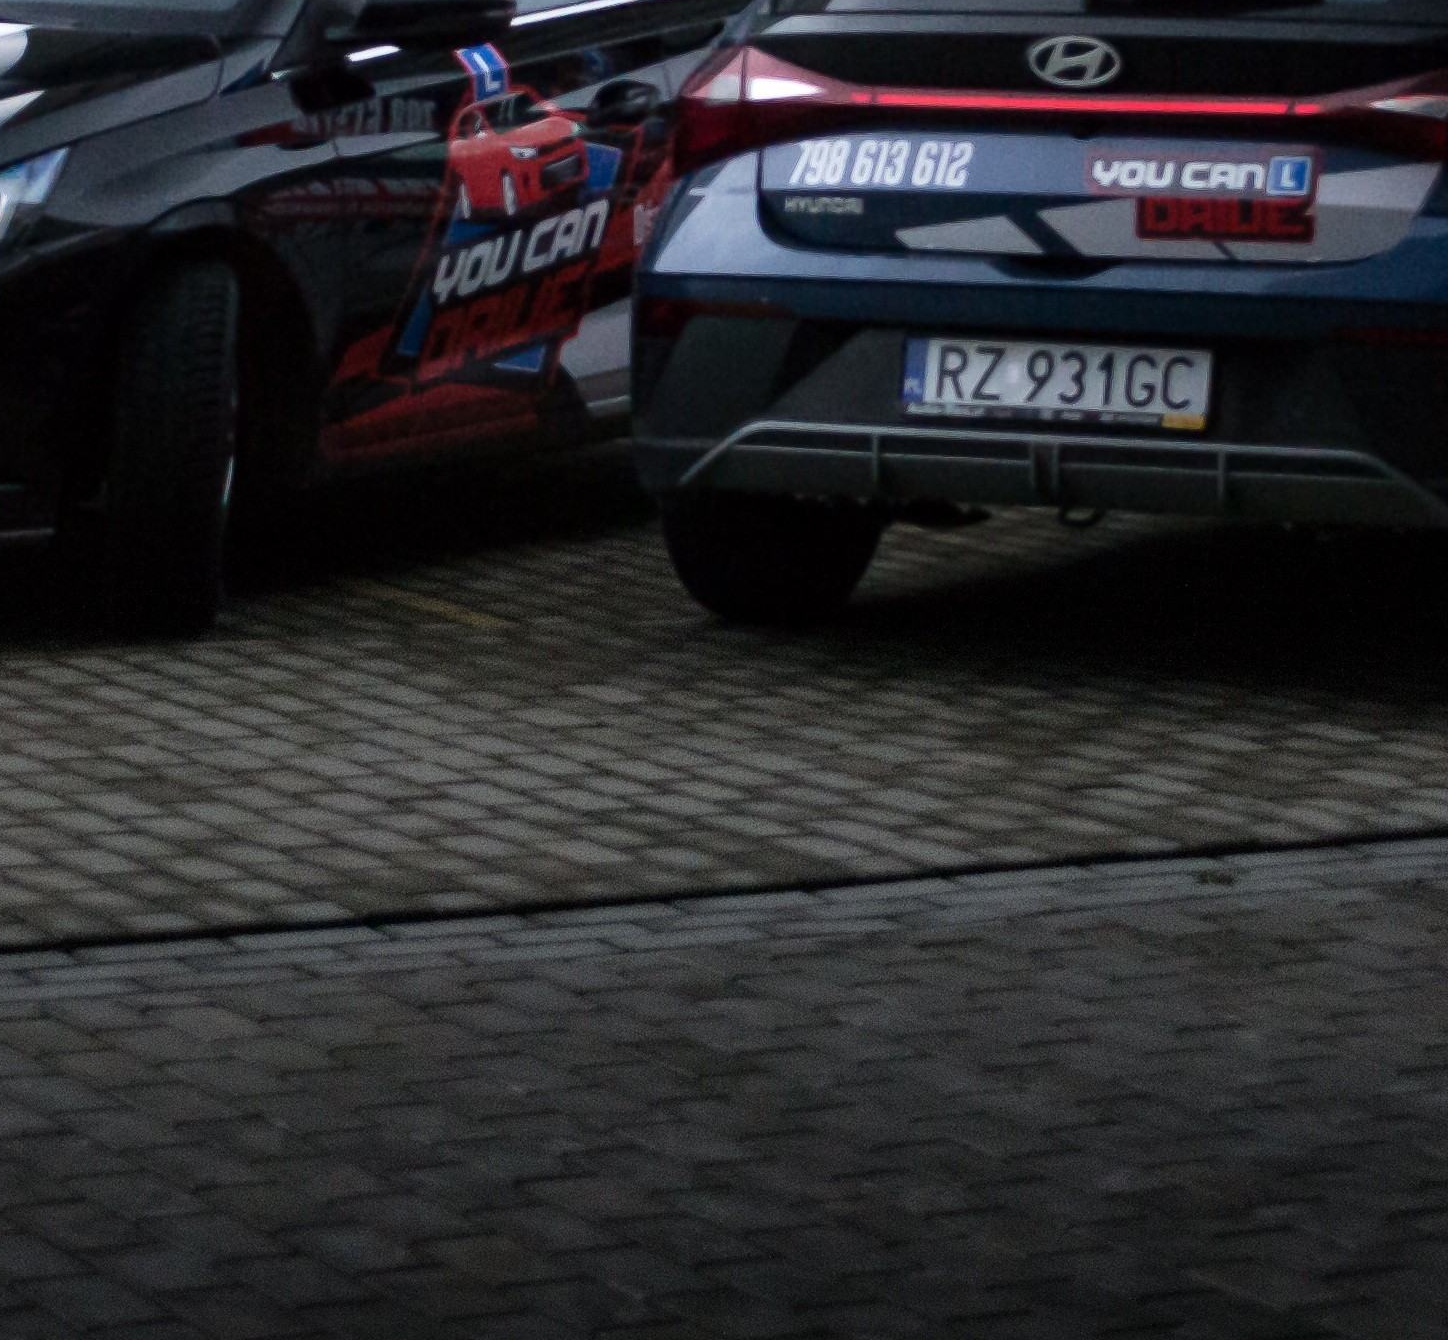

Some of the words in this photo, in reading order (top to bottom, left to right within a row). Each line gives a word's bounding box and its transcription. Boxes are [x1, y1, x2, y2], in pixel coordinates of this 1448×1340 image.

[474, 51, 501, 90] L
[788, 140, 851, 186] 798
[850, 140, 911, 186] 613
[912, 141, 973, 187] 612
[1092, 160, 1175, 189] YOU
[1280, 163, 1295, 188] L
[433, 231, 523, 305] YOU
[937, 346, 1005, 401] RZ
[1024, 350, 1193, 409] 931GC
